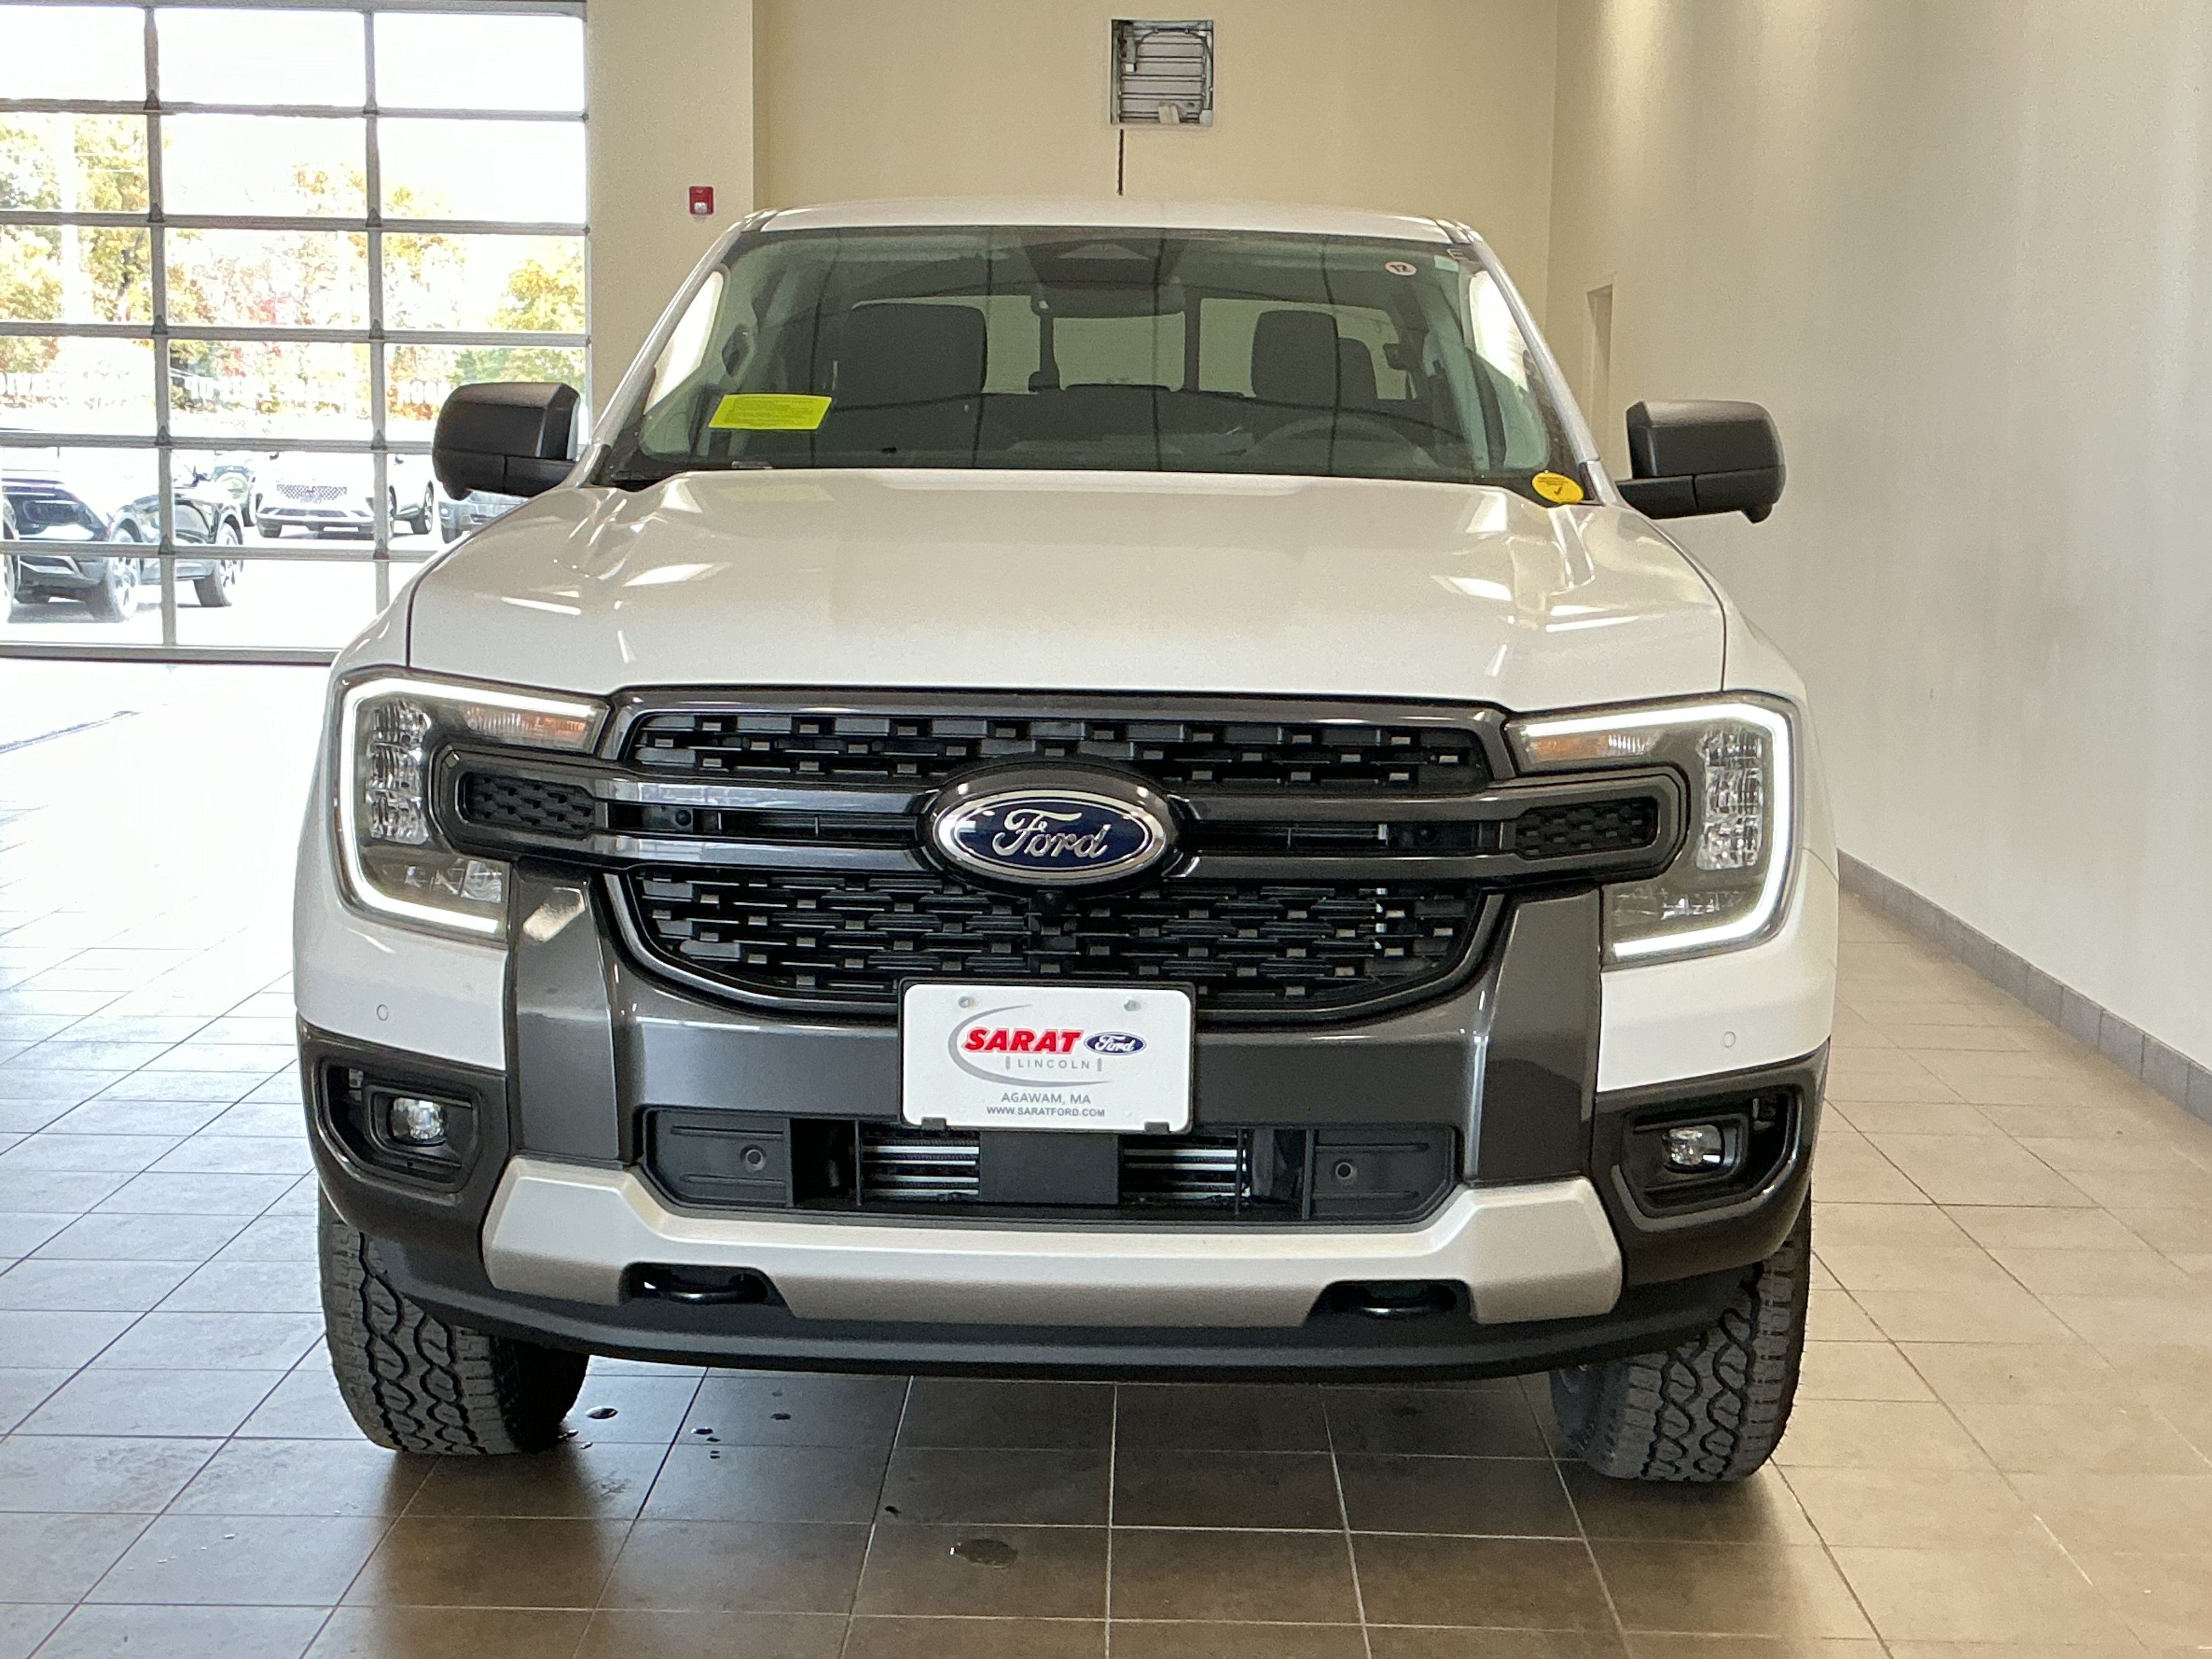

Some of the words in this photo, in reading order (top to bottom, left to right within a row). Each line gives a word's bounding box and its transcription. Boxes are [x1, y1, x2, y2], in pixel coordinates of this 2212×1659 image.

[992, 808, 1111, 858] Ford
[964, 1028, 1083, 1053] SARAT
[1094, 1035, 1136, 1052] Ford
[1018, 1058, 1090, 1069] LINCOLN
[1001, 1092, 1066, 1105] AGAWAM,
[1070, 1093, 1091, 1104] MA
[986, 1106, 1105, 1117] WWW.SARATFORD.COM
